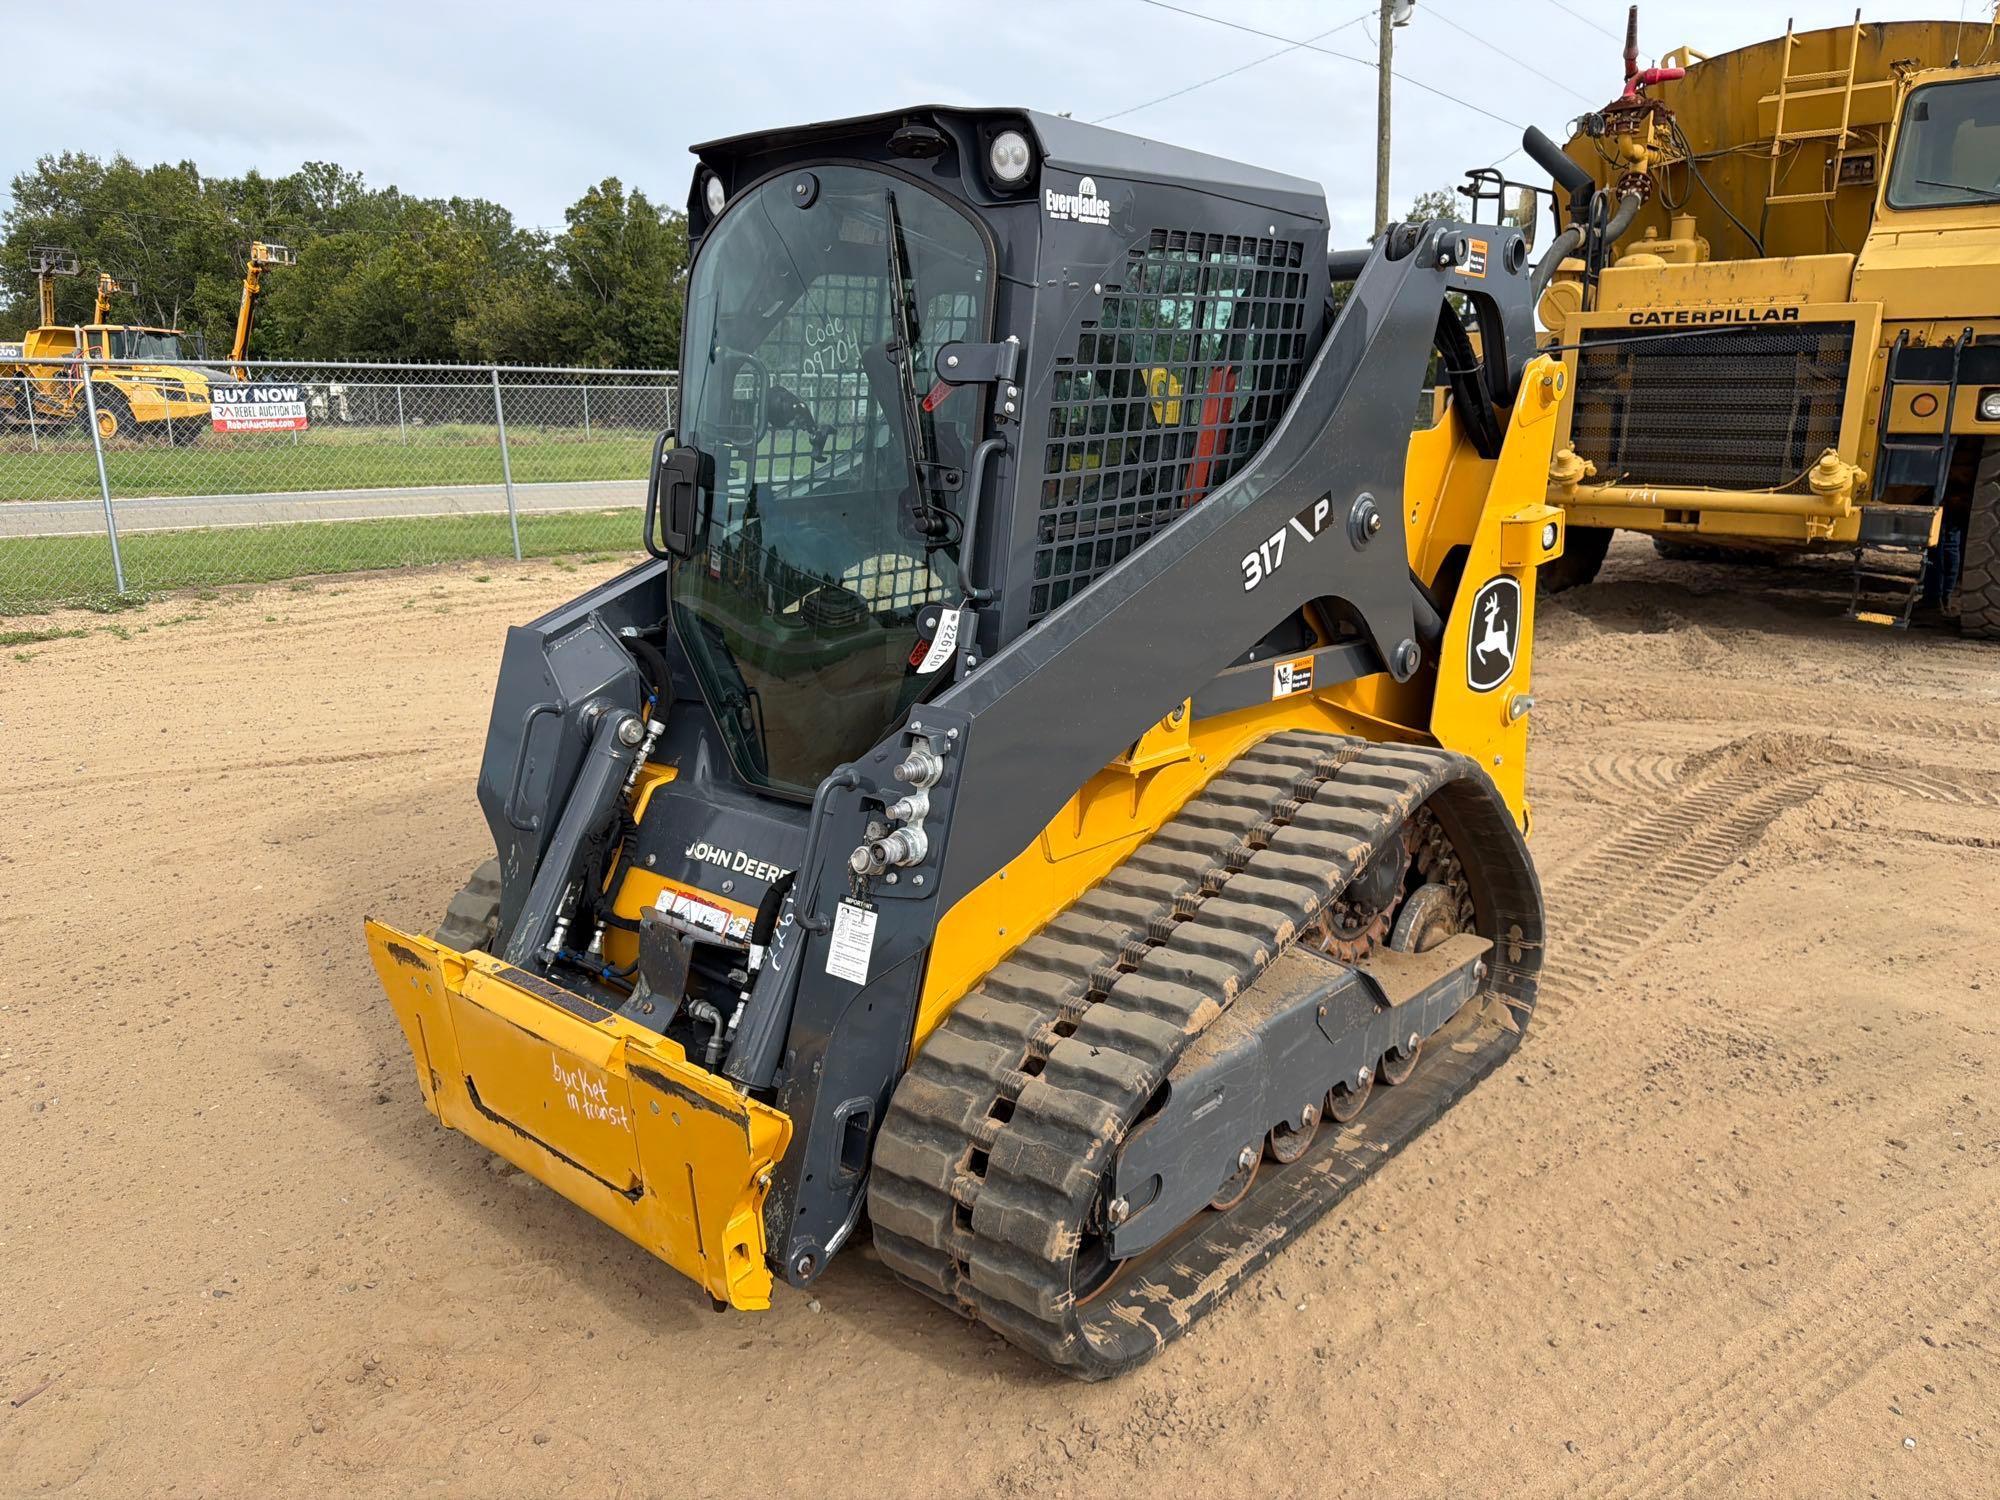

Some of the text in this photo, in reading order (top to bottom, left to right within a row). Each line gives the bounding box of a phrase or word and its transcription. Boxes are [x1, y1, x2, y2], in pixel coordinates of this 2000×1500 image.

[1046, 188, 1110, 219] Everglades
[806, 314, 845, 347] Code
[1629, 308, 1799, 325] CATERPILLAR
[803, 328, 862, 375] 09704
[213, 388, 298, 402] BUY NOW
[226, 420, 295, 430] RebelAuction.com
[234, 406, 257, 418] REBEL
[259, 405, 290, 417] AUCTION
[1241, 498, 1329, 591] 317 P
[929, 623, 957, 667] 226160
[685, 842, 732, 868] JOHN
[845, 896, 873, 910] IMPORTNT
[552, 1051, 609, 1105] bucket
[583, 1096, 631, 1133] transit
